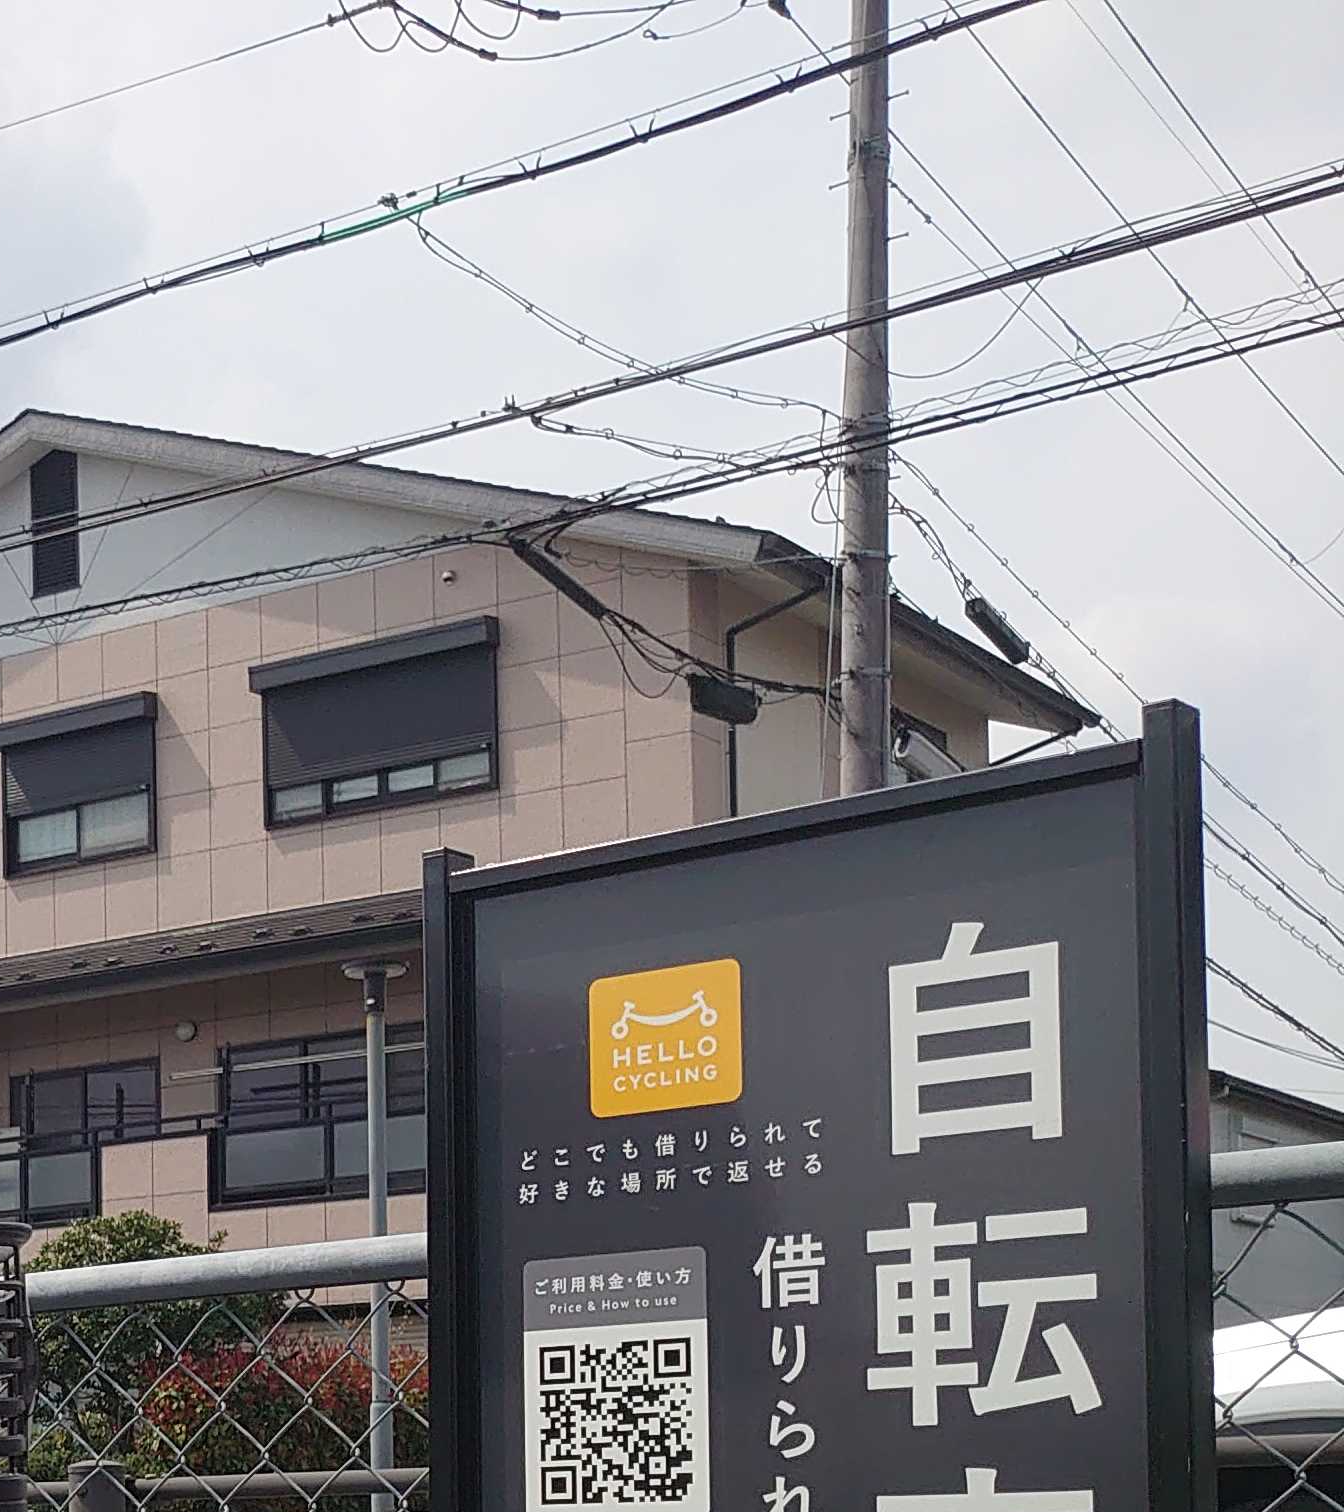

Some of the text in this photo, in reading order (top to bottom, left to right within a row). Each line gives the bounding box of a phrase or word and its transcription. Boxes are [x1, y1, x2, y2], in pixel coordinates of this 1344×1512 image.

[612, 1035, 718, 1068] HELLO
[613, 1064, 718, 1092] CYCLING
[520, 1118, 823, 1171] どこでも借りられて
[519, 1155, 823, 1205] 好きな場所で返せる
[535, 1267, 692, 1296] ご利用料金・使い方
[549, 1295, 678, 1315] Price & How to use
